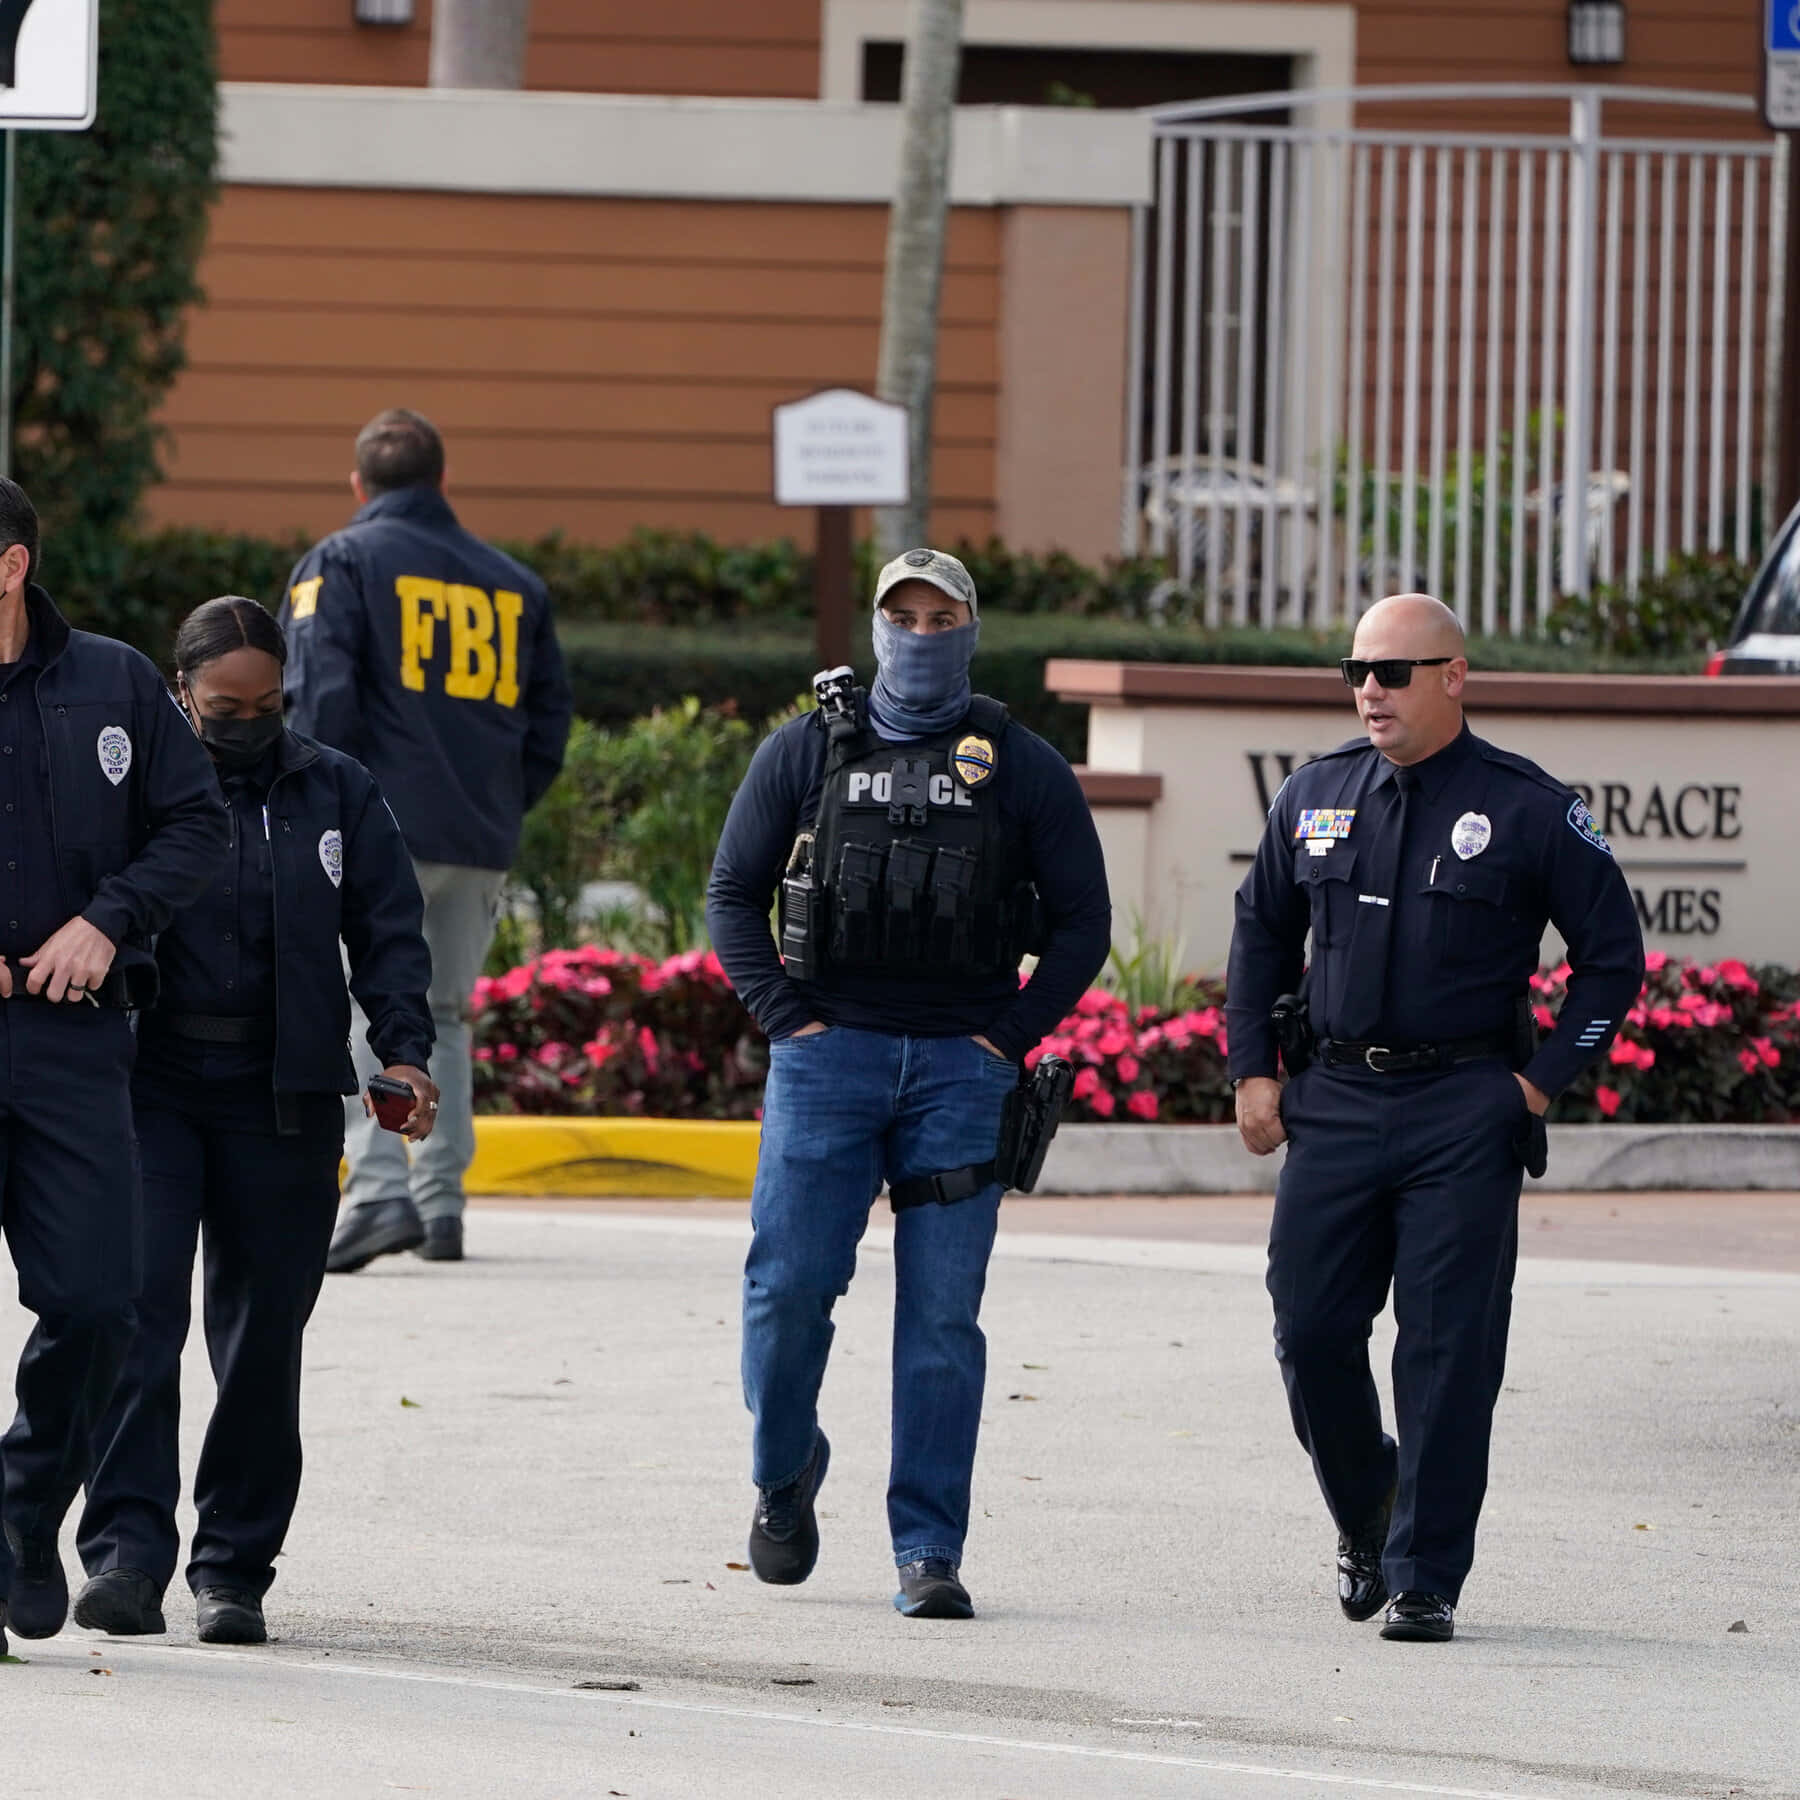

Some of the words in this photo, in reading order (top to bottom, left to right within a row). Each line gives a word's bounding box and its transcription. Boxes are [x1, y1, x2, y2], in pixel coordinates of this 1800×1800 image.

[395, 575, 524, 708] FBI
[848, 772, 973, 806] POCE
[1633, 888, 1721, 935] MES
